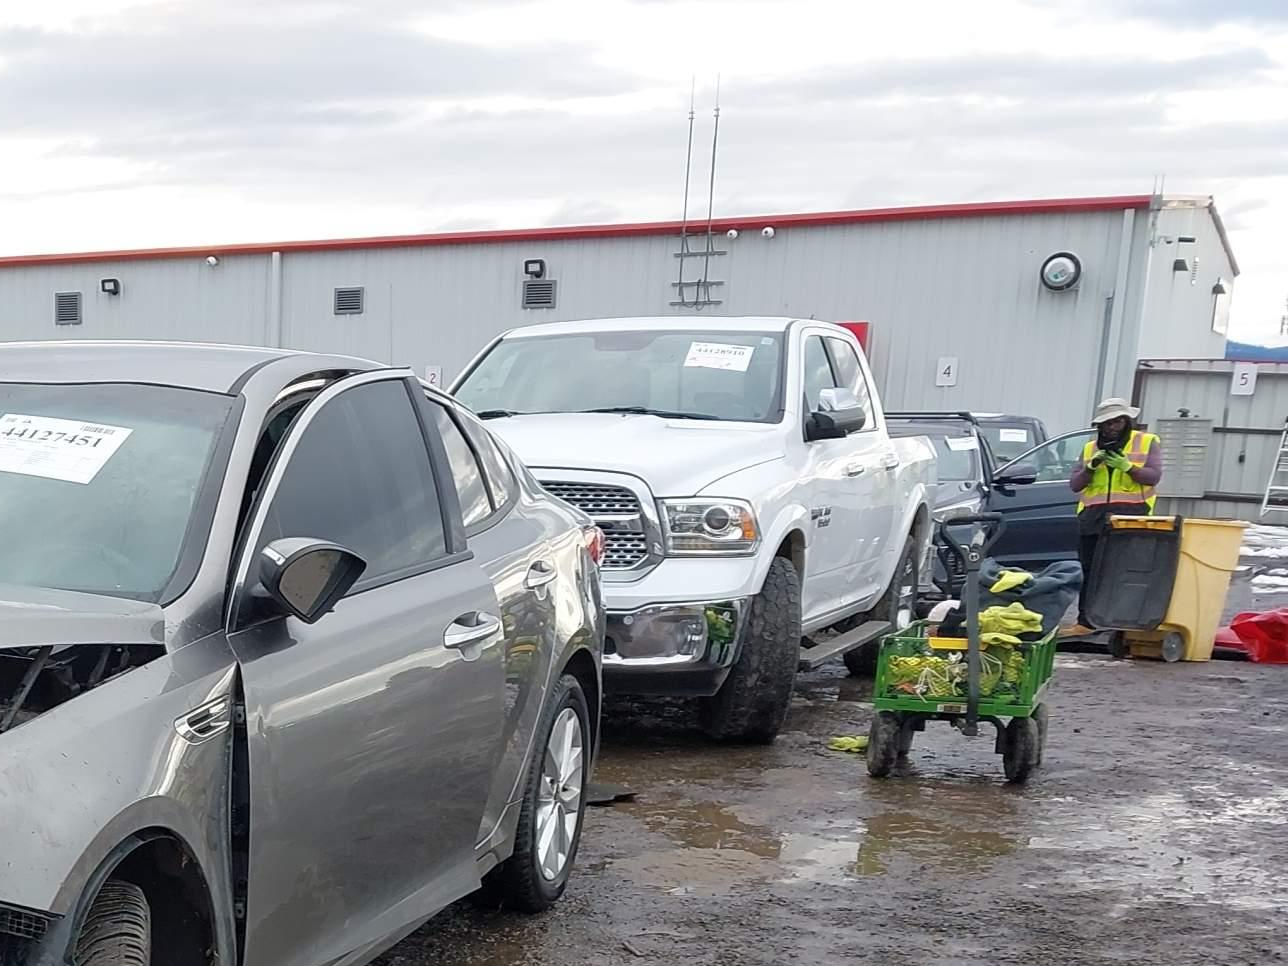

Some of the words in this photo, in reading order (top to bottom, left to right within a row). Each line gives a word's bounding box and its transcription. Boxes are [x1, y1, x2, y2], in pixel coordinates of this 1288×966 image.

[429, 372, 437, 384] 2
[942, 364, 952, 378] 4
[1239, 372, 1249, 386] 5
[1, 426, 103, 448] 44127451
